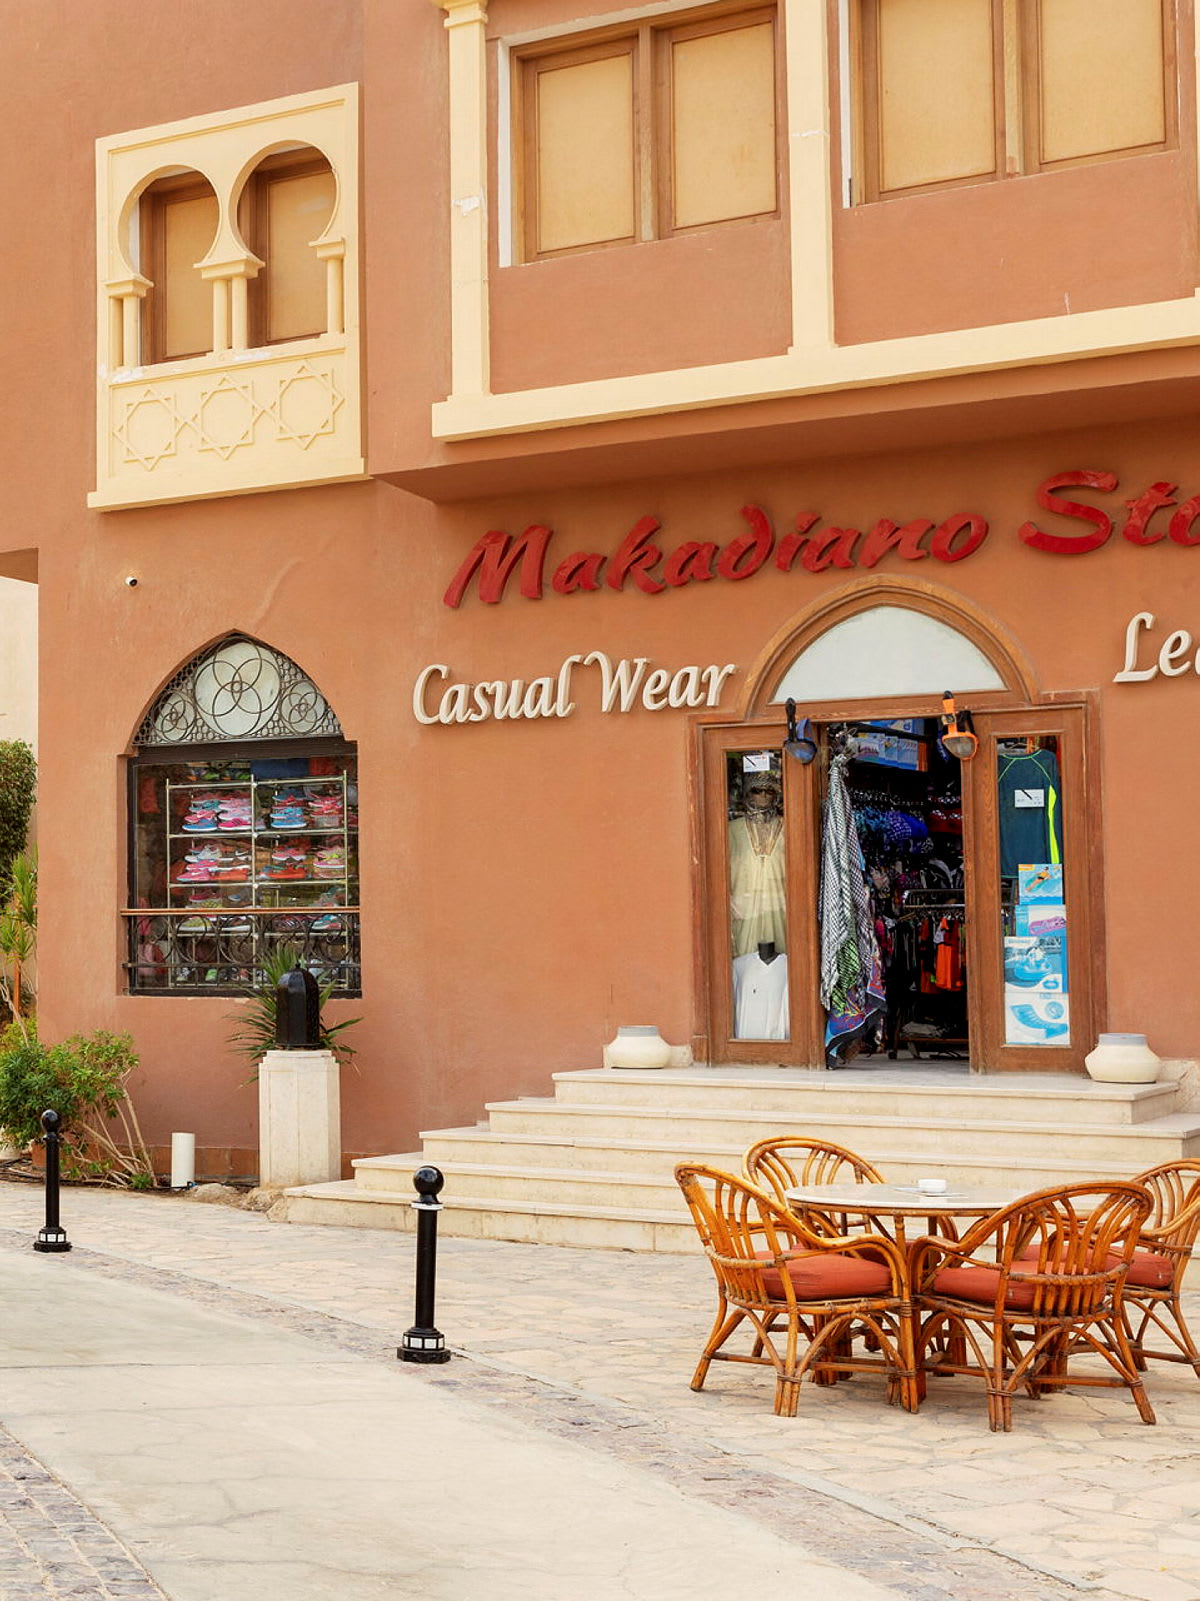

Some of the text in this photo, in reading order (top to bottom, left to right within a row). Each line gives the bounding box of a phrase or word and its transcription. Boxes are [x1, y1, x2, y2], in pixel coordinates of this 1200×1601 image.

[443, 505, 990, 609] Makadiano
[1112, 612, 1200, 683] Le
[412, 650, 737, 726] Casual Wear
